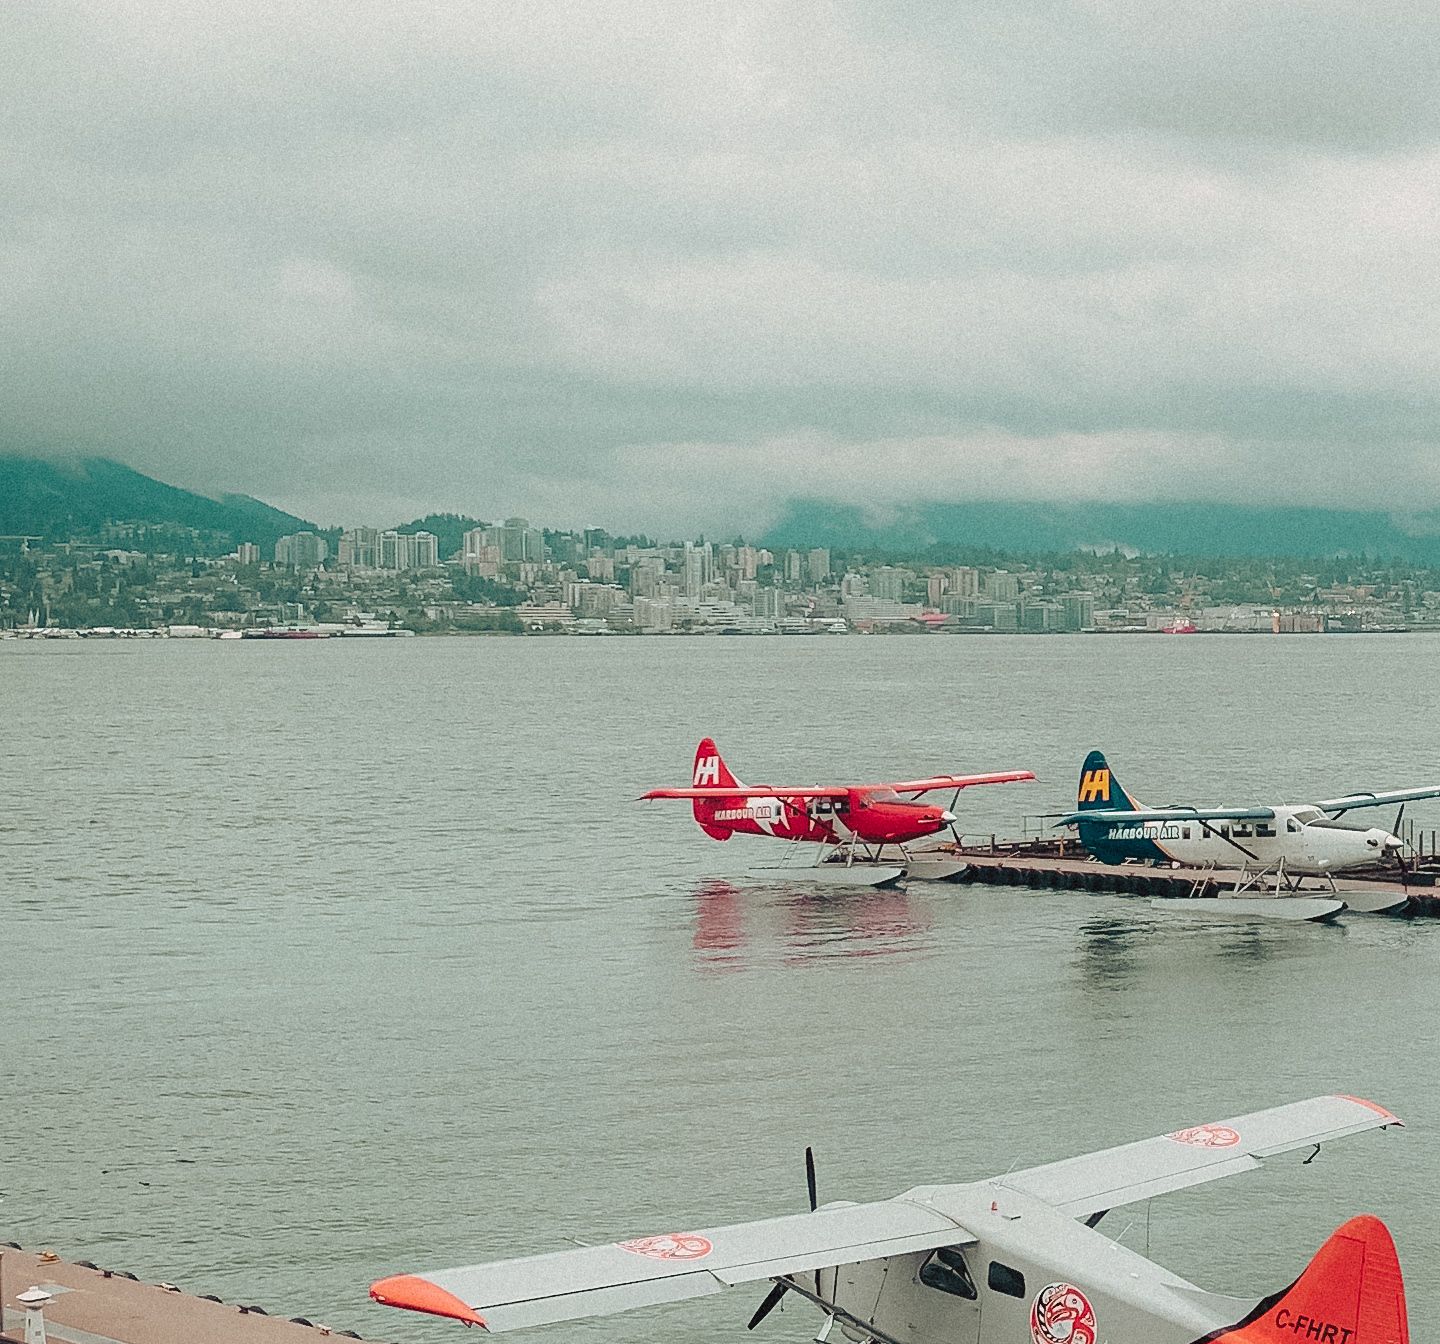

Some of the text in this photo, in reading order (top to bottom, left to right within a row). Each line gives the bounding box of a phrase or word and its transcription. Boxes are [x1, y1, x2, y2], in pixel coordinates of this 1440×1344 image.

[1079, 769, 1110, 801] HA
[714, 806, 771, 821] HARBOUR AIR
[1108, 825, 1180, 839] HARBOUR AIR
